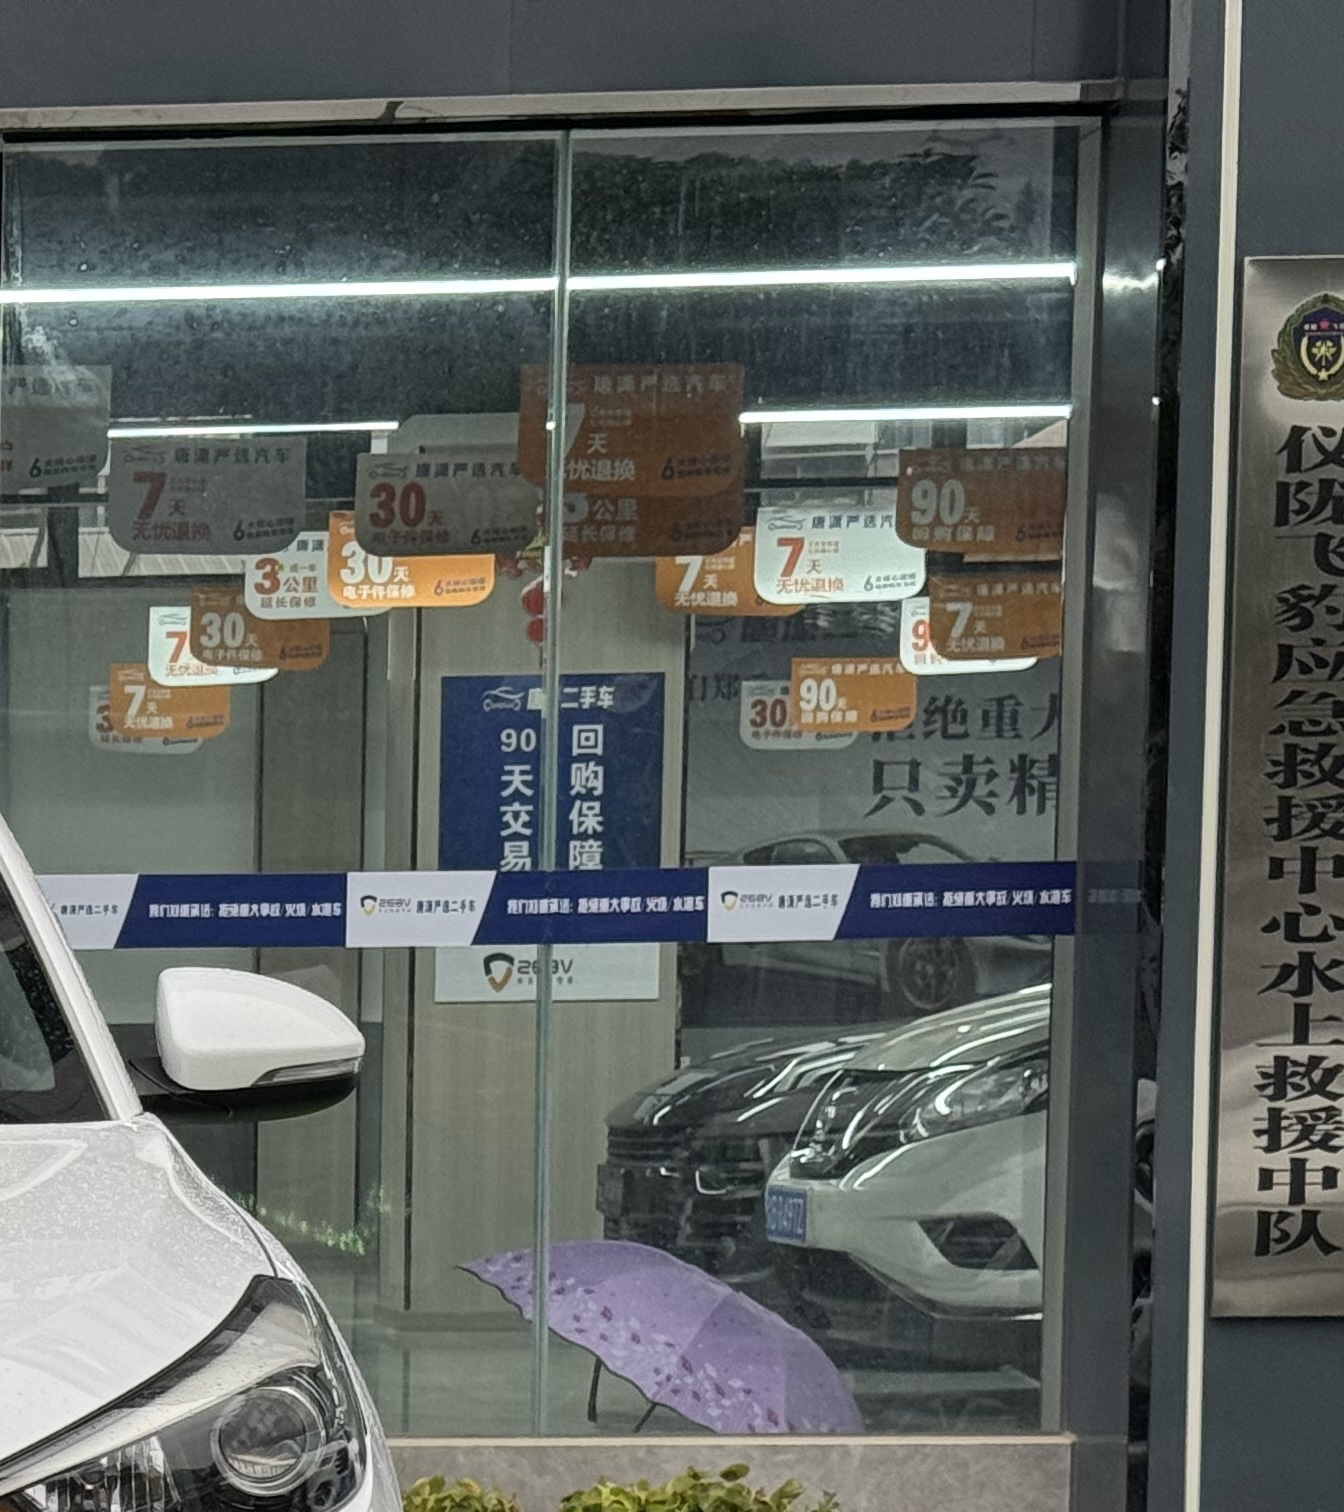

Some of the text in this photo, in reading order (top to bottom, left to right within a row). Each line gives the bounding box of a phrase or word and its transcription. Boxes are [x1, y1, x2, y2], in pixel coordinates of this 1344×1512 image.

[562, 458, 636, 482] 忧退换
[812, 513, 895, 529] 唐潇严选汽
[282, 576, 319, 594] 公里
[870, 692, 1058, 743] 绝重大
[862, 753, 1058, 818] 只卖精
